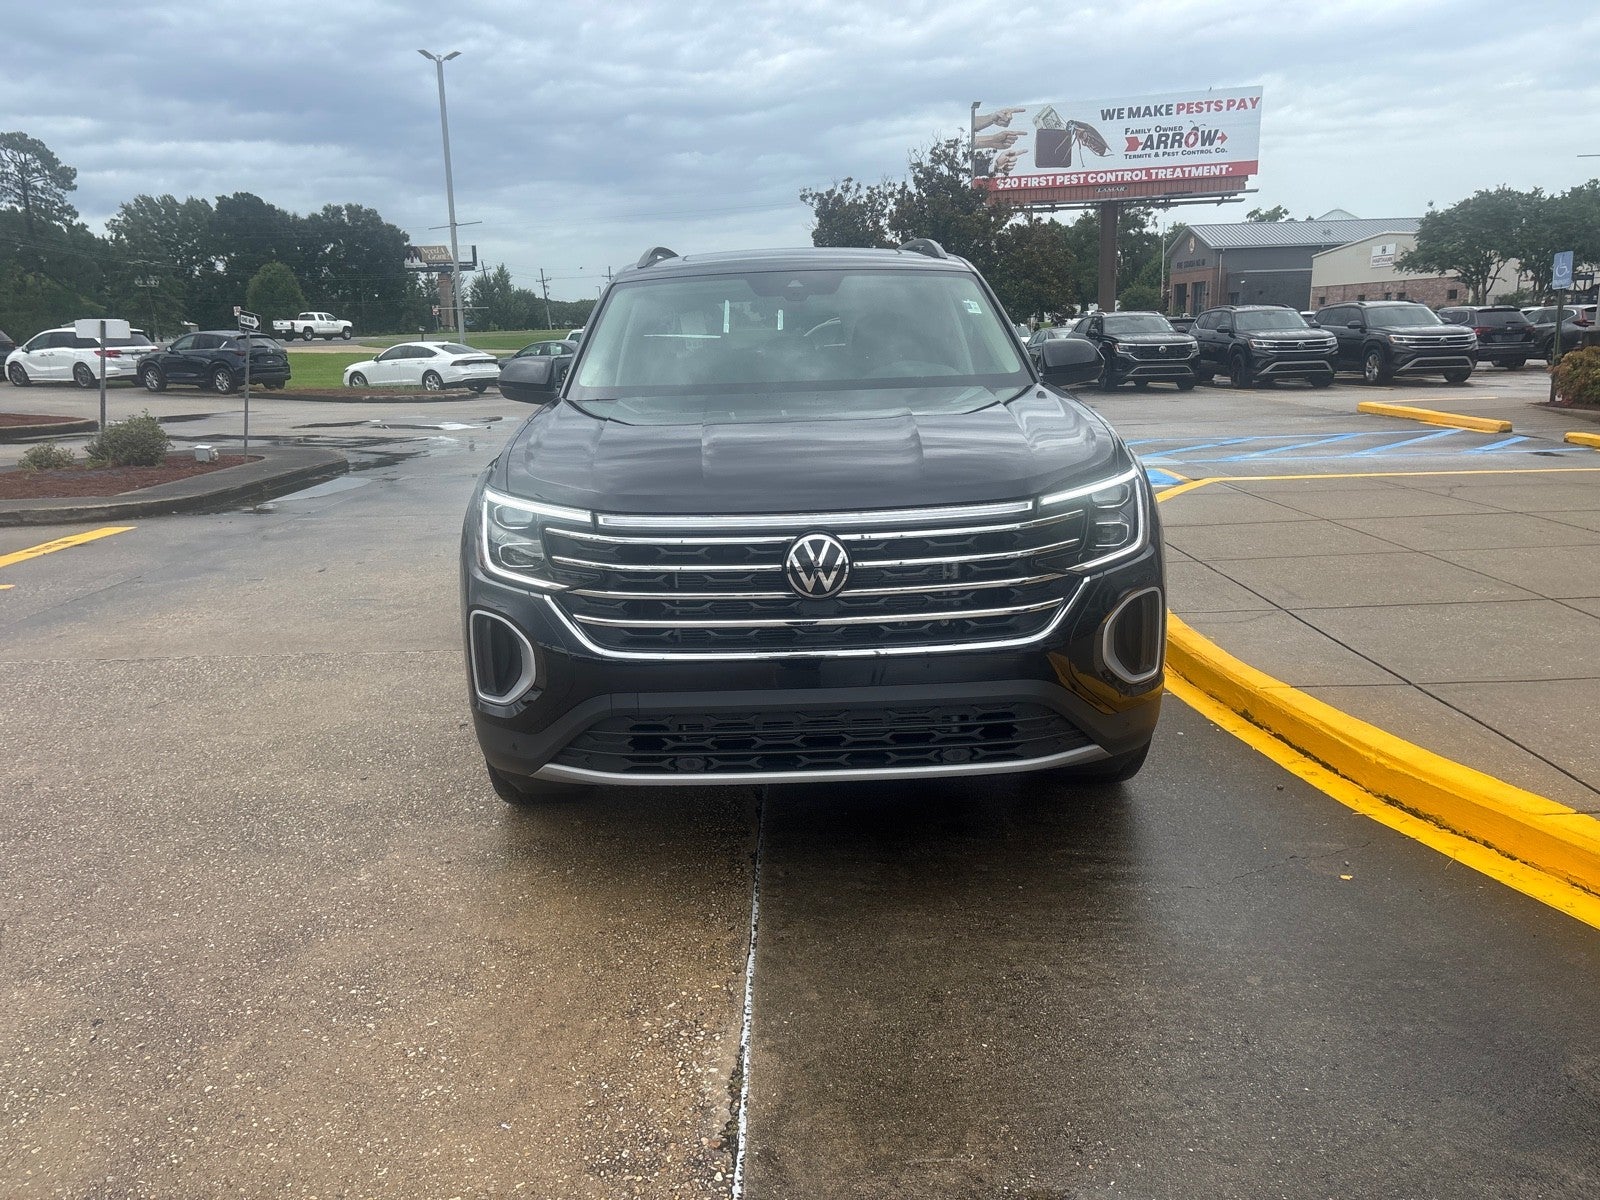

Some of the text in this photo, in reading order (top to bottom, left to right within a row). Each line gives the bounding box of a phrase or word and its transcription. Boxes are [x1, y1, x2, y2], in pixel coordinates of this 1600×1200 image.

[1101, 97, 1260, 121] WE MAKE PESTS PAY
[1141, 129, 1219, 151] ARROW
[996, 177, 1019, 190] $20
[1020, 175, 1054, 188] FIRST
[1056, 173, 1086, 186] PEST
[1087, 170, 1148, 183] CONTROL
